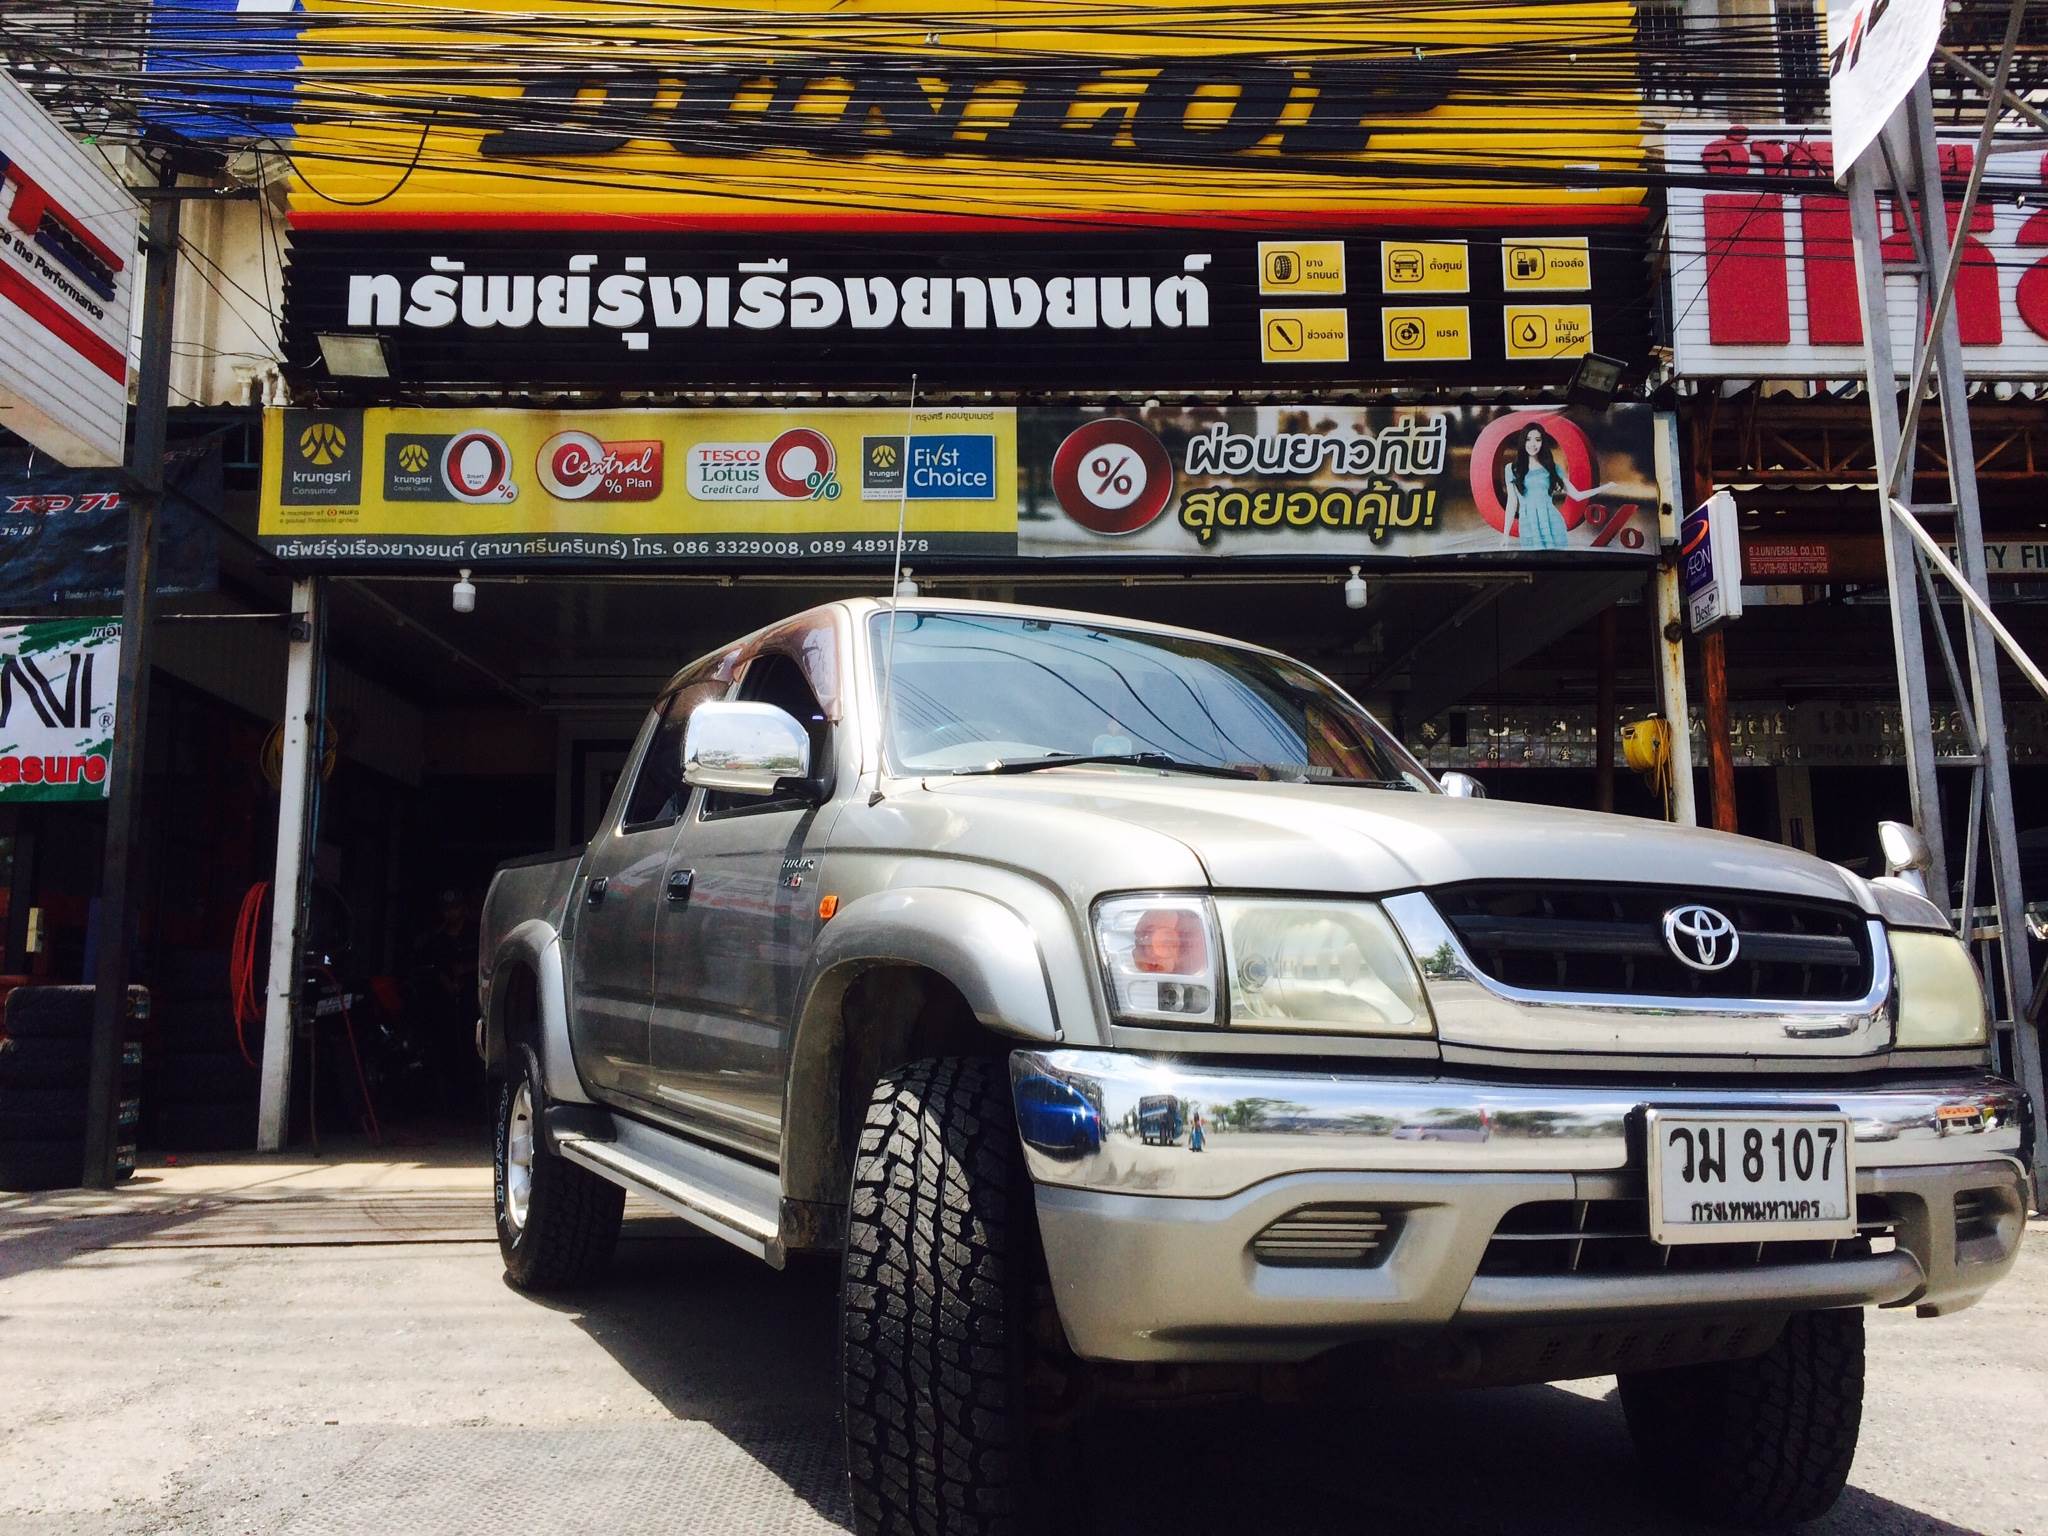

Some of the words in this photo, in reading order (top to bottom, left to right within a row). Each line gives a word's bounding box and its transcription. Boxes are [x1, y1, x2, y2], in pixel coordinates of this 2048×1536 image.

[1305, 259, 1324, 268] ยาง
[1429, 257, 1463, 273] ตั้งศูนย์
[13, 235, 33, 263] the
[34, 256, 104, 322] Performance
[1306, 268, 1340, 280] รถยนต์
[347, 252, 1212, 350] ทรัพย์รุ่งเรืองยางยนต์
[1554, 318, 1580, 332] น้ำมัน
[1307, 329, 1344, 341] ช่วงล่าง
[1436, 328, 1459, 338] เบรค
[1188, 415, 1445, 473] ผ่อนยาวที่นี่
[561, 447, 653, 476] Central
[700, 450, 761, 462] TESCO
[292, 470, 352, 485] krungsri
[393, 475, 433, 486] krungsri
[701, 467, 760, 482] Lotus
[868, 470, 900, 478] krungsri
[913, 468, 987, 487] Choice
[626, 477, 653, 488] Plan
[701, 485, 734, 495] Credit
[735, 485, 760, 495] Card
[291, 486, 338, 496] Consumer
[74, 492, 120, 513] 71
[1183, 480, 1437, 541] สุดยอดคุ้ม!
[276, 539, 464, 560] ทรัพย์รุ่งเรืองยางยนต์
[632, 537, 667, 556] โทร.
[673, 541, 709, 554] 086
[715, 541, 804, 557] 3329008,
[809, 540, 846, 555] 089
[1669, 1127, 1727, 1183] วม
[1742, 1127, 1838, 1183] 8107
[1691, 1200, 1821, 1222] กรงเทพมหานคร
